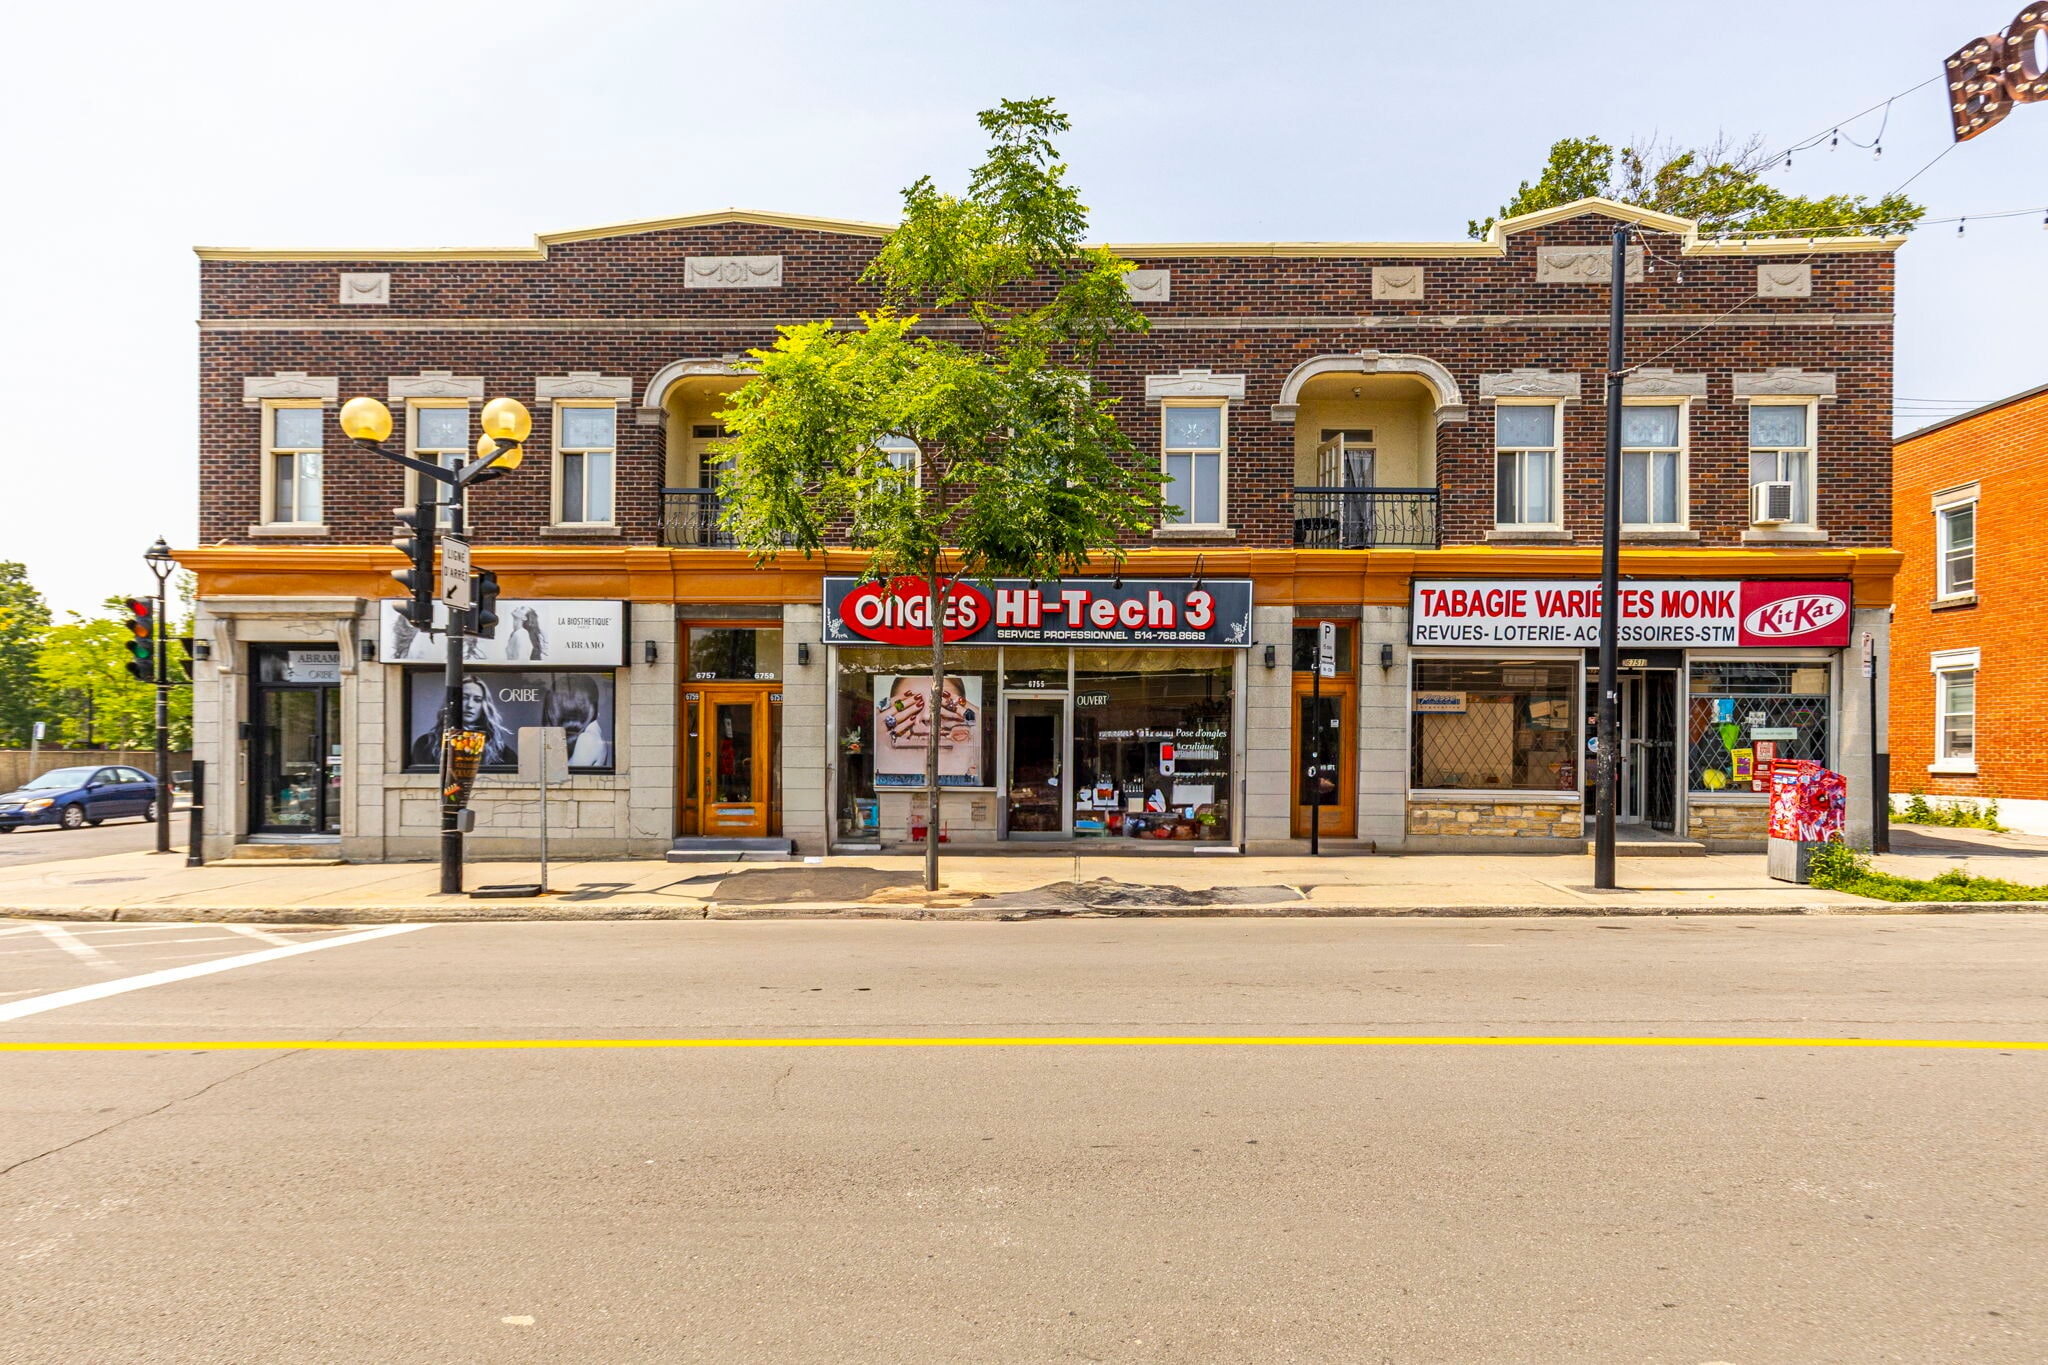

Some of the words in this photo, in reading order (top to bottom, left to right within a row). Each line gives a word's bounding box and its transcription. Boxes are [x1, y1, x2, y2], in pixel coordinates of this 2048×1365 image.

[448, 549, 465, 563] LIGNE
[1420, 589, 1527, 618] TABAGIE
[1535, 583, 1654, 618] VARIÉES
[1661, 590, 1736, 619] MONK
[995, 590, 1177, 629] Hi-Tech
[1185, 590, 1216, 631] 3
[558, 617, 566, 626] LA
[997, 630, 1041, 640] SERVICE
[1043, 630, 1129, 641] PROFESSIONNEL
[1134, 631, 1206, 641] 514-768.8668
[1325, 625, 1331, 639] P
[565, 641, 604, 649] ABRAMO
[754, 672, 775, 680] 6759
[1028, 680, 1045, 688] 6755
[499, 688, 540, 703] ORIBE
[1077, 695, 1107, 706] OUVERT
[1175, 728, 1194, 738] Pose
[1195, 728, 1227, 740] d'ongles
